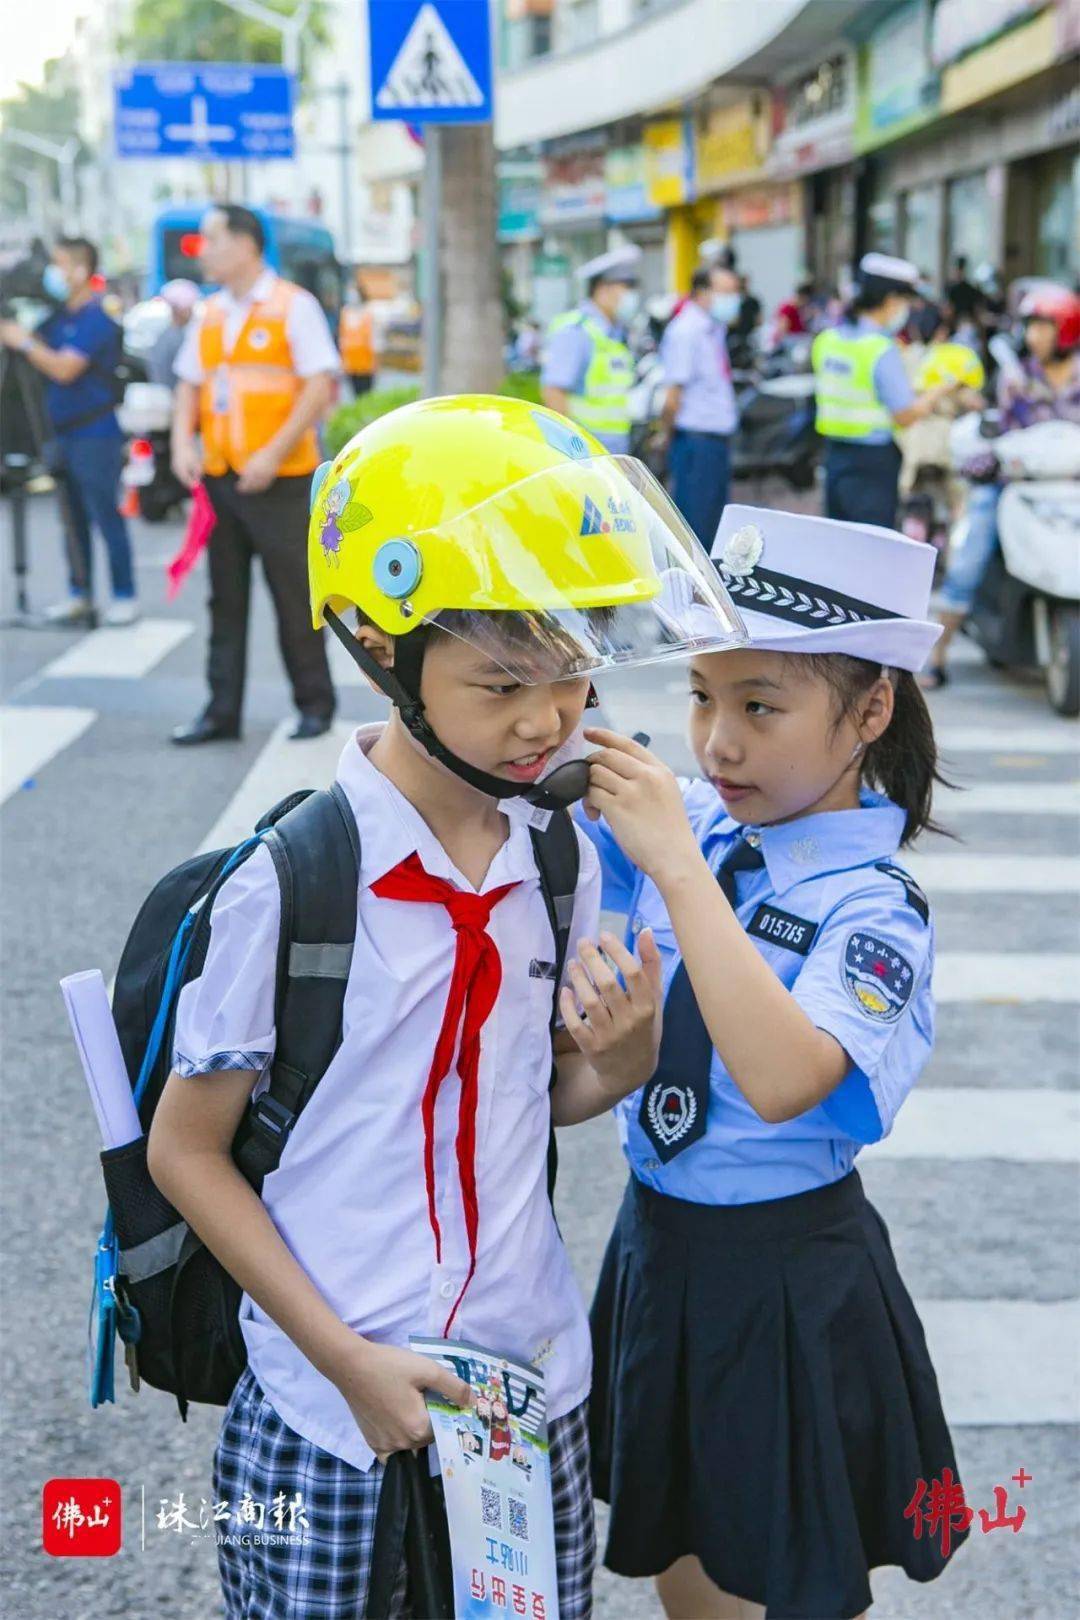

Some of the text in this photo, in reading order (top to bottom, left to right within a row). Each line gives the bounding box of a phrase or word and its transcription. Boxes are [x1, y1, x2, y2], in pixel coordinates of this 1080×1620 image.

[759, 913, 806, 944] 015765
[485, 1536, 528, 1577] 小贴士
[471, 1568, 546, 1620] 安全出行
